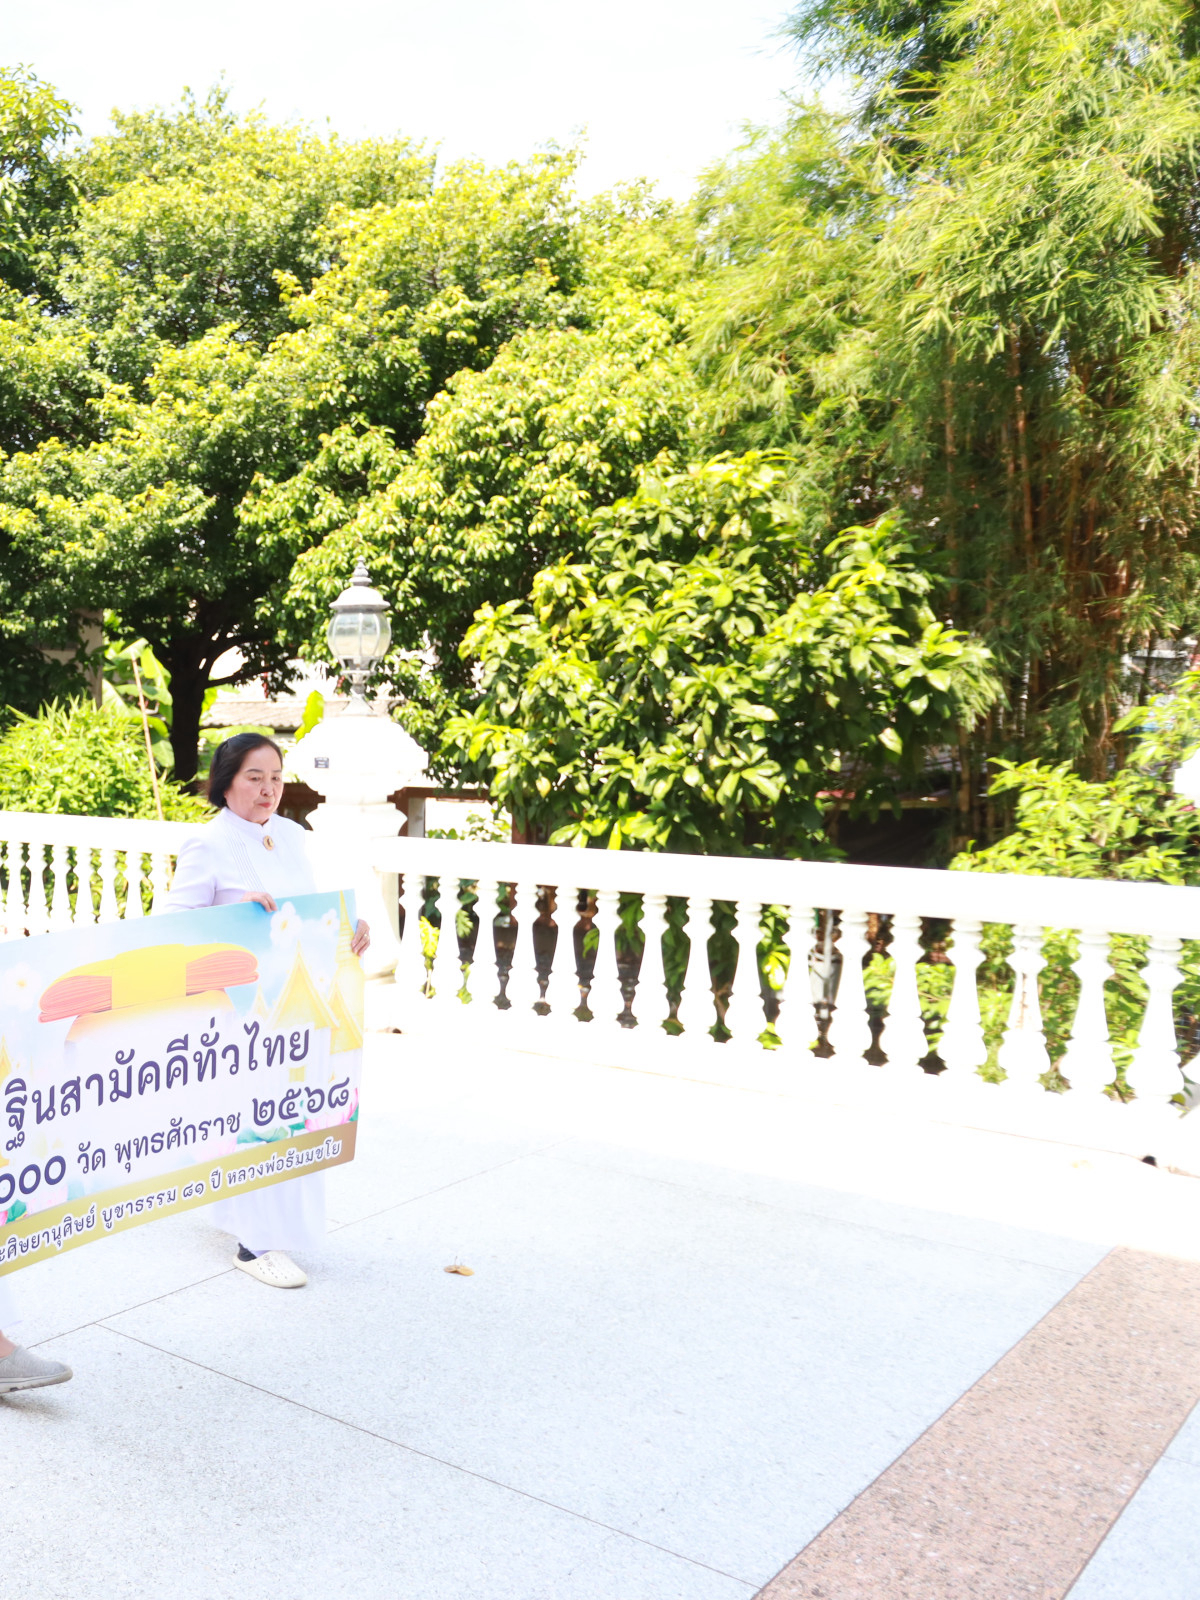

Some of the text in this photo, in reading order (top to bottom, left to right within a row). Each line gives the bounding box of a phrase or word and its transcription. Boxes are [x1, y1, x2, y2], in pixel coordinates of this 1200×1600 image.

[77, 1141, 106, 1174] วัด
[114, 1111, 241, 1173] พุทธศักราช
[252, 1077, 350, 1127] ๒๕๖๘
[102, 1188, 176, 1229] บูชาธรรม
[183, 1183, 205, 1198] ๘๑
[211, 1171, 222, 1190] ปี
[228, 1139, 341, 1186] หลวงพ่อธัมมชโย
